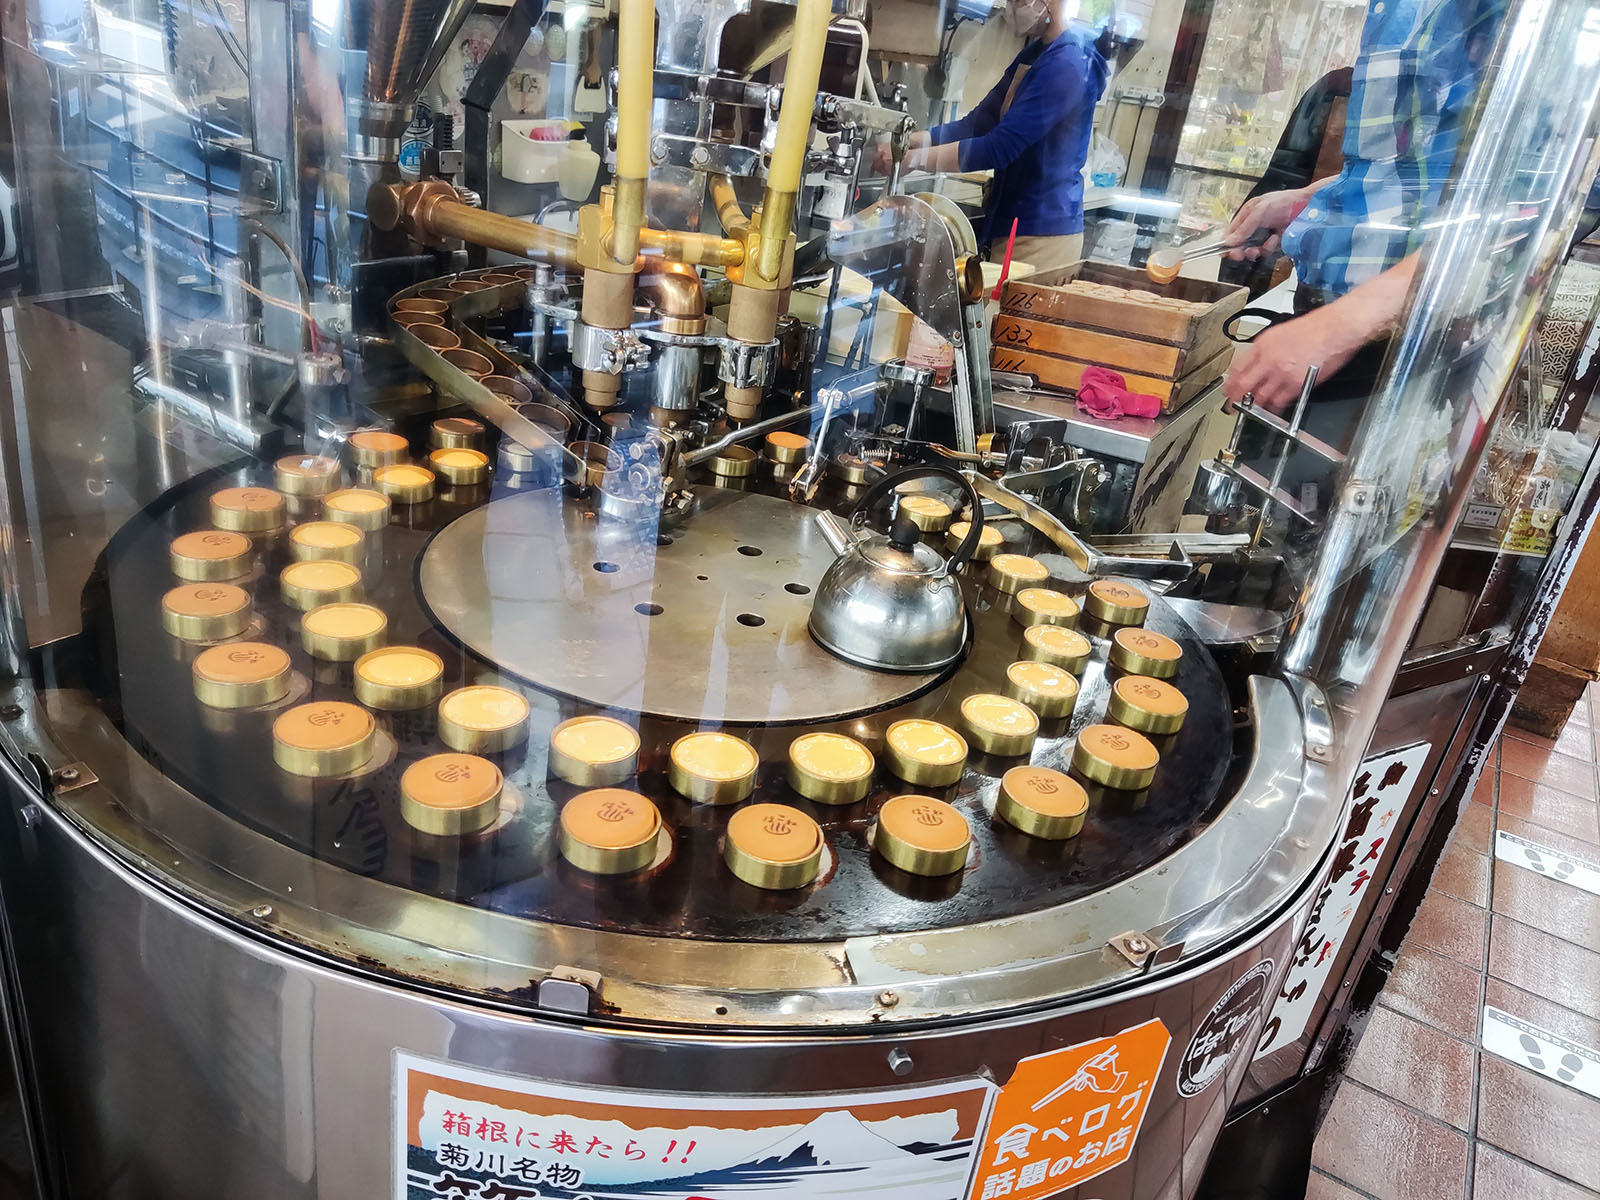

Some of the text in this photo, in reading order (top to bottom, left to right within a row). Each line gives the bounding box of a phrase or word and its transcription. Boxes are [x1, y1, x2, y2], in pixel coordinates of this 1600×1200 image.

[996, 324, 1033, 345] 132
[992, 1079, 1149, 1166] 食べログ
[440, 1142, 581, 1186] 菊川名物
[980, 1125, 1132, 1200] 話題のお店
